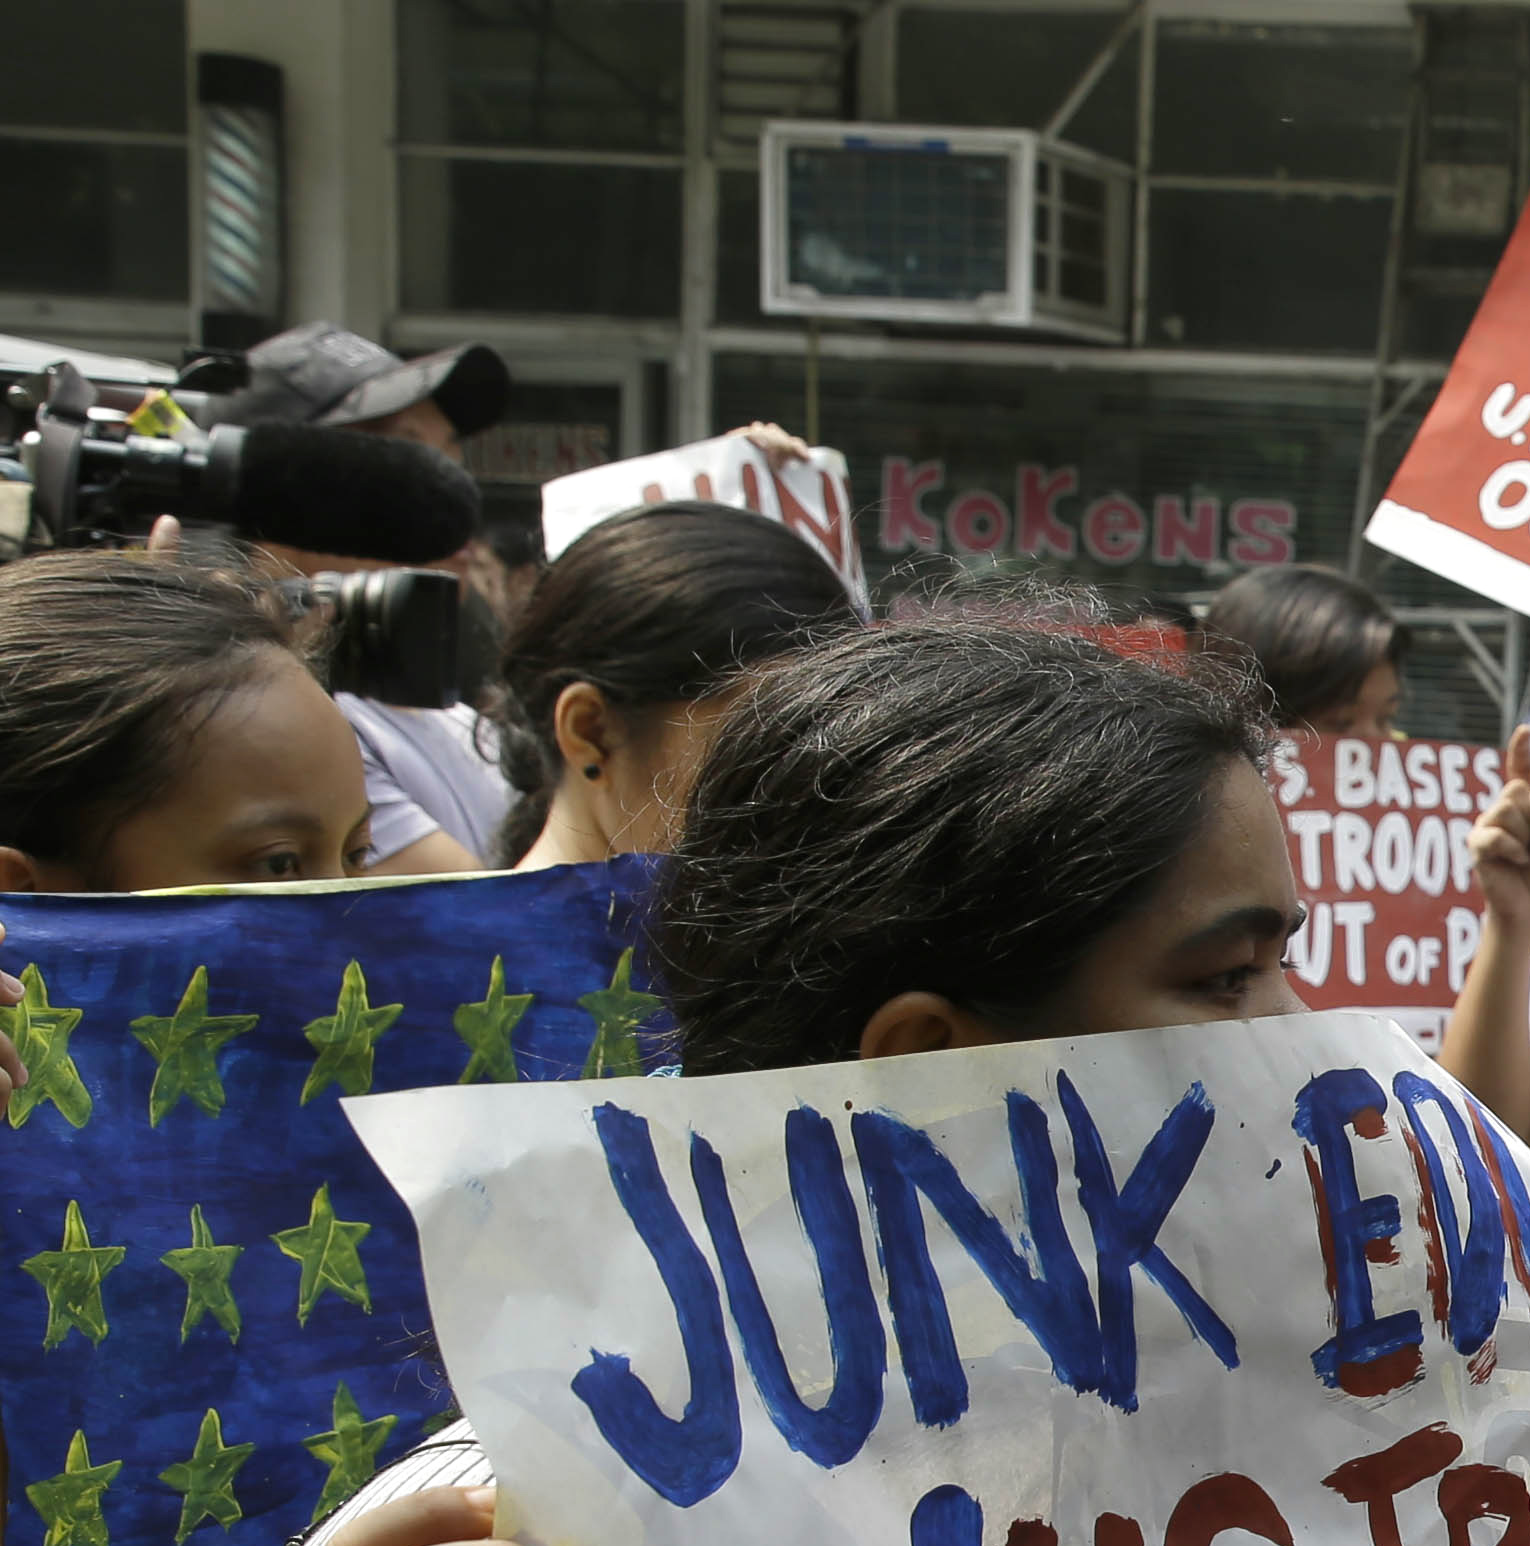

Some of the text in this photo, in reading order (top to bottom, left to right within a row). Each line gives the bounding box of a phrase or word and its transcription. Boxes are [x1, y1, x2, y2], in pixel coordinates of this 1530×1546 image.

[1334, 738, 1502, 814] BASES
[1286, 809, 1477, 897] TROOP
[1282, 900, 1376, 988] UT
[1386, 934, 1443, 987] OF
[569, 1068, 1241, 1509] JUNK
